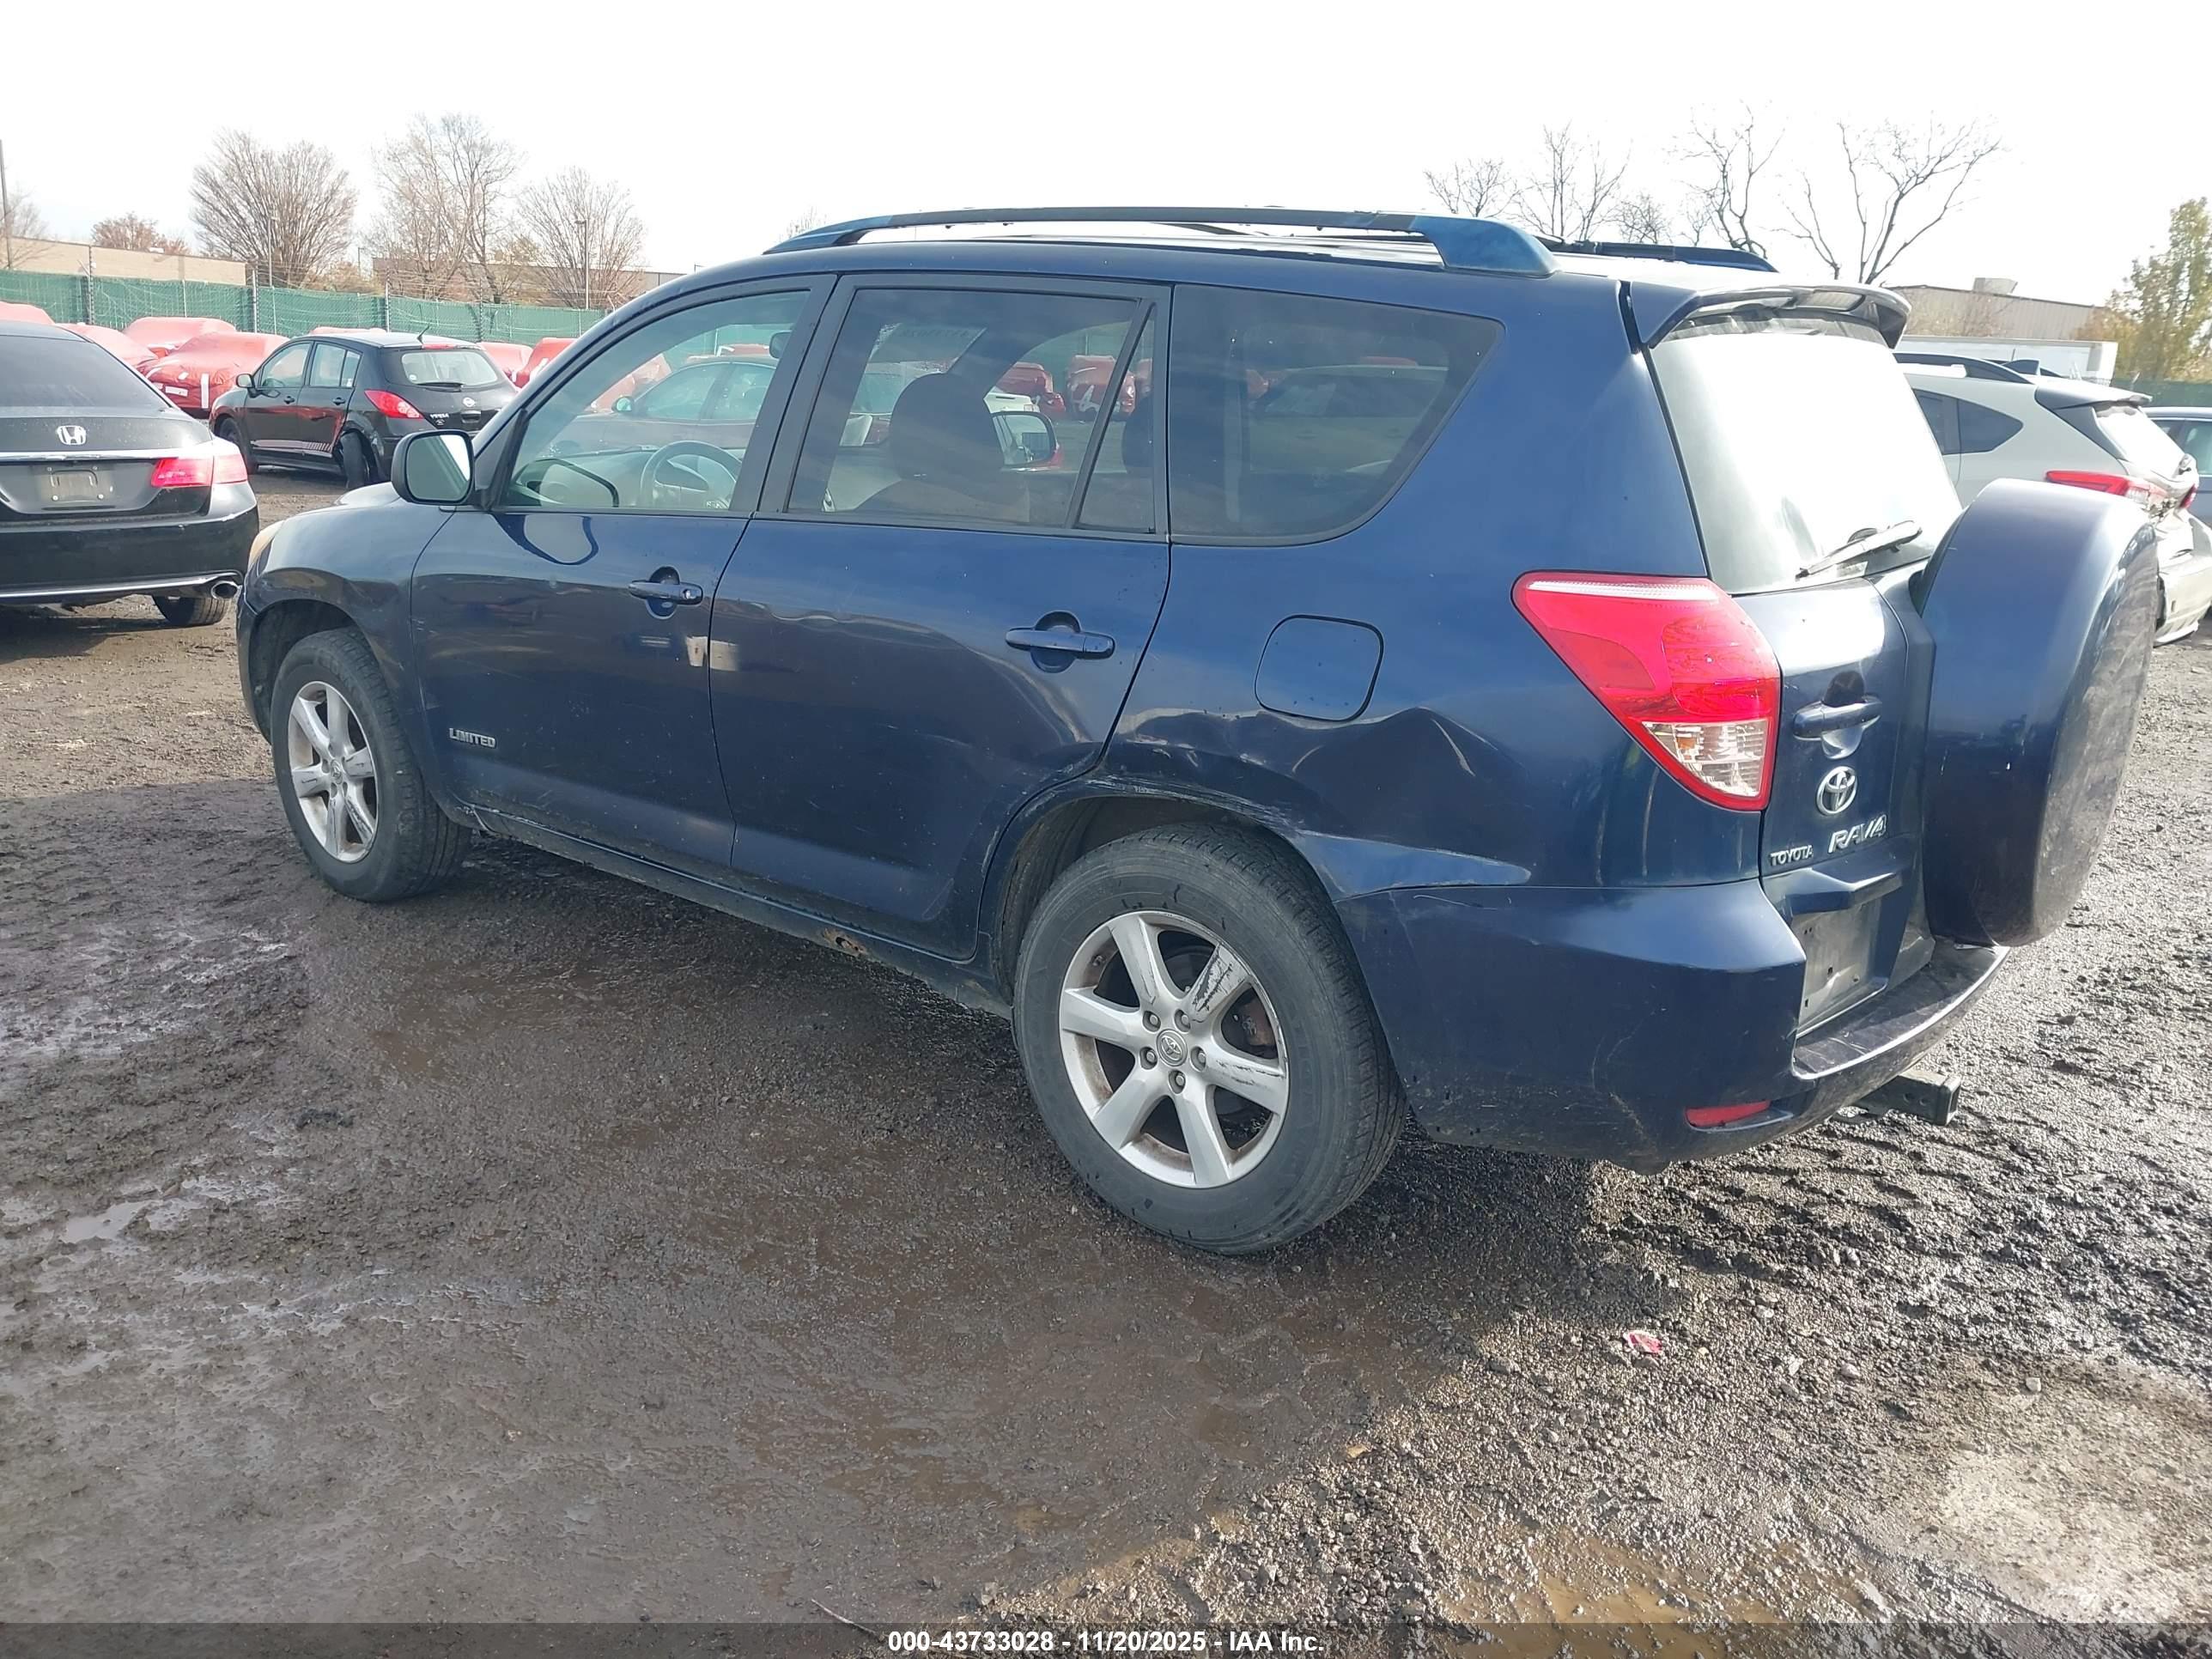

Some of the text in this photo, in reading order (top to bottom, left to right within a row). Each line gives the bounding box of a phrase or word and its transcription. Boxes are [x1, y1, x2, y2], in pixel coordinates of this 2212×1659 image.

[449, 728, 495, 748] LIMITED
[1828, 814, 1887, 853] RAV4
[1771, 845, 1814, 866] TOYOTA
